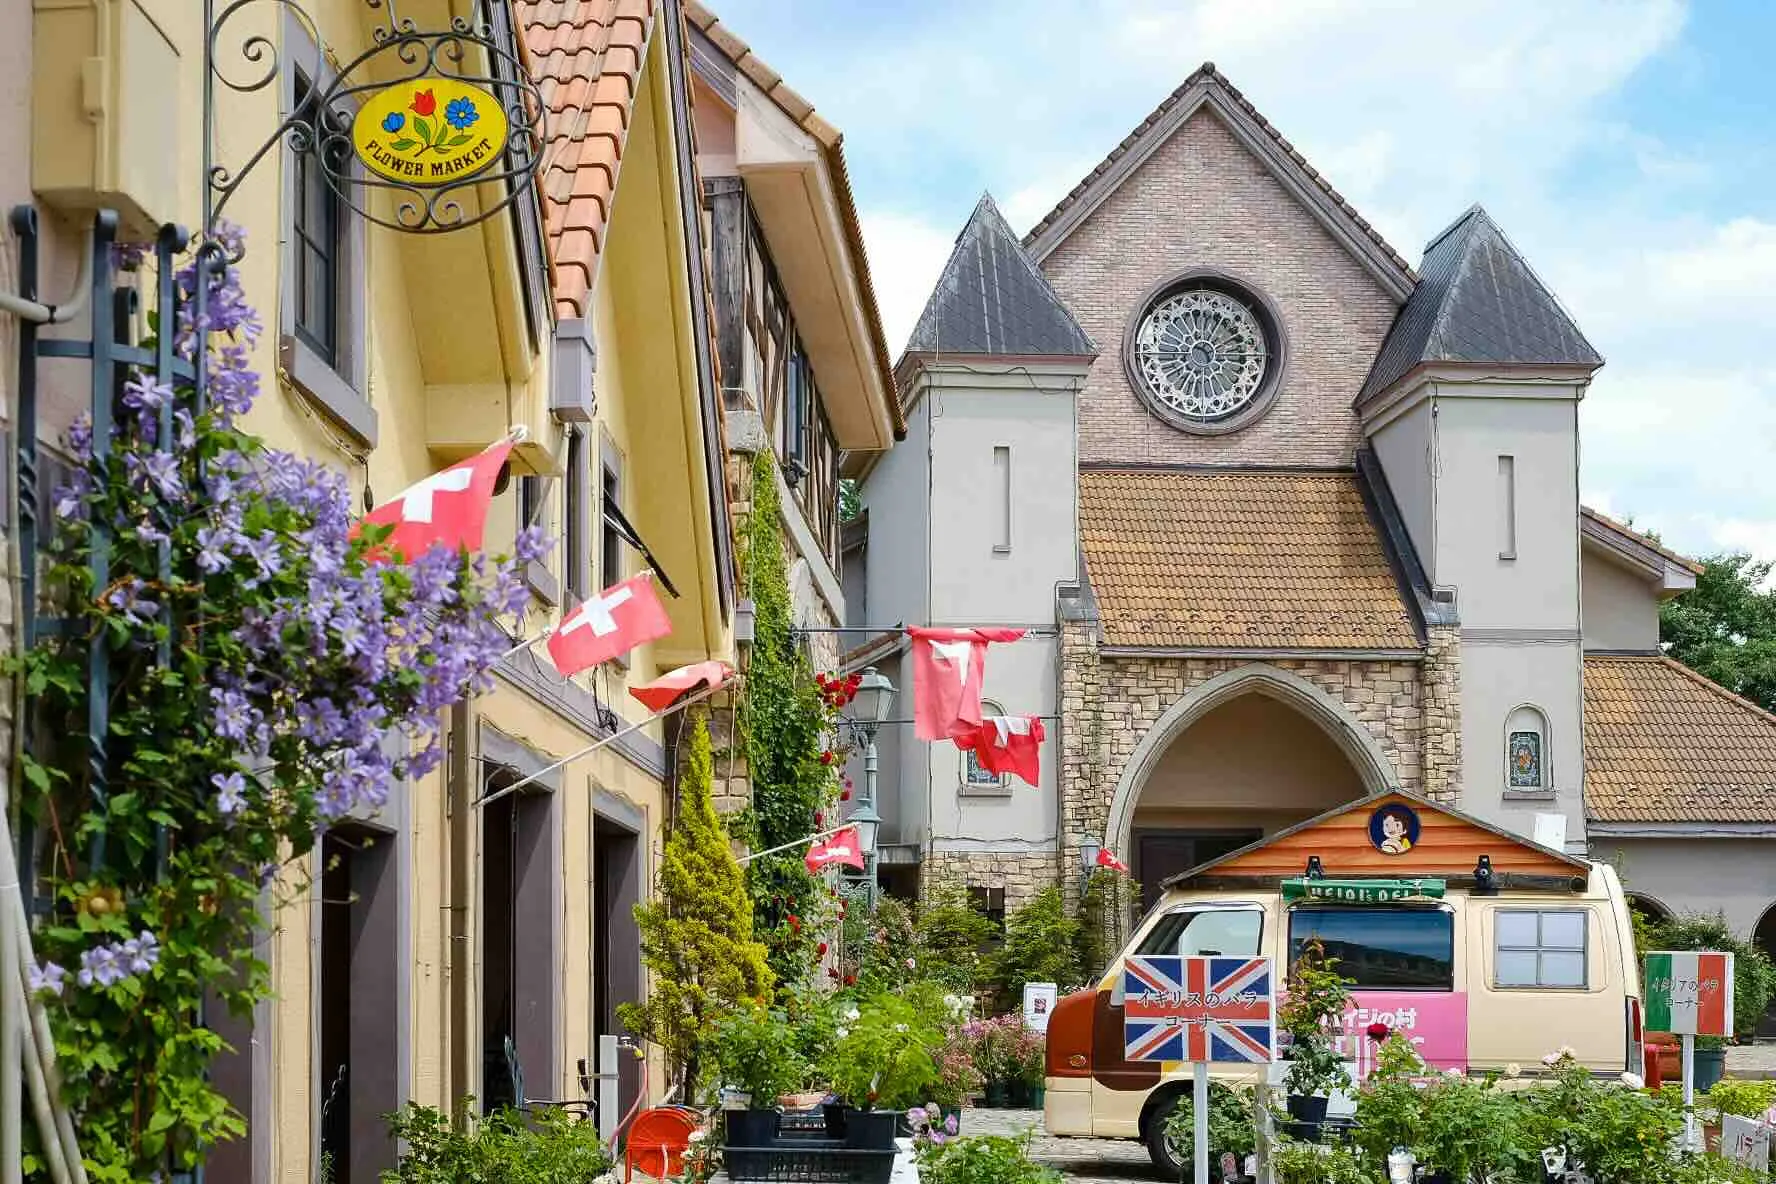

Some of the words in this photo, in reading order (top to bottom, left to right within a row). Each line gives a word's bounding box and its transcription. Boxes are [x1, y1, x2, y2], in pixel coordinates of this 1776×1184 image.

[365, 140, 424, 177] FLOWER
[431, 138, 492, 177] MARKET
[1652, 976, 1720, 993] イタリアのバラ
[1137, 989, 1258, 1010] イギリスのバラ
[1664, 997, 1704, 1009] コーナー
[1165, 1013, 1232, 1032] コーナー
[1319, 1007, 1417, 1030] ハイジの村
